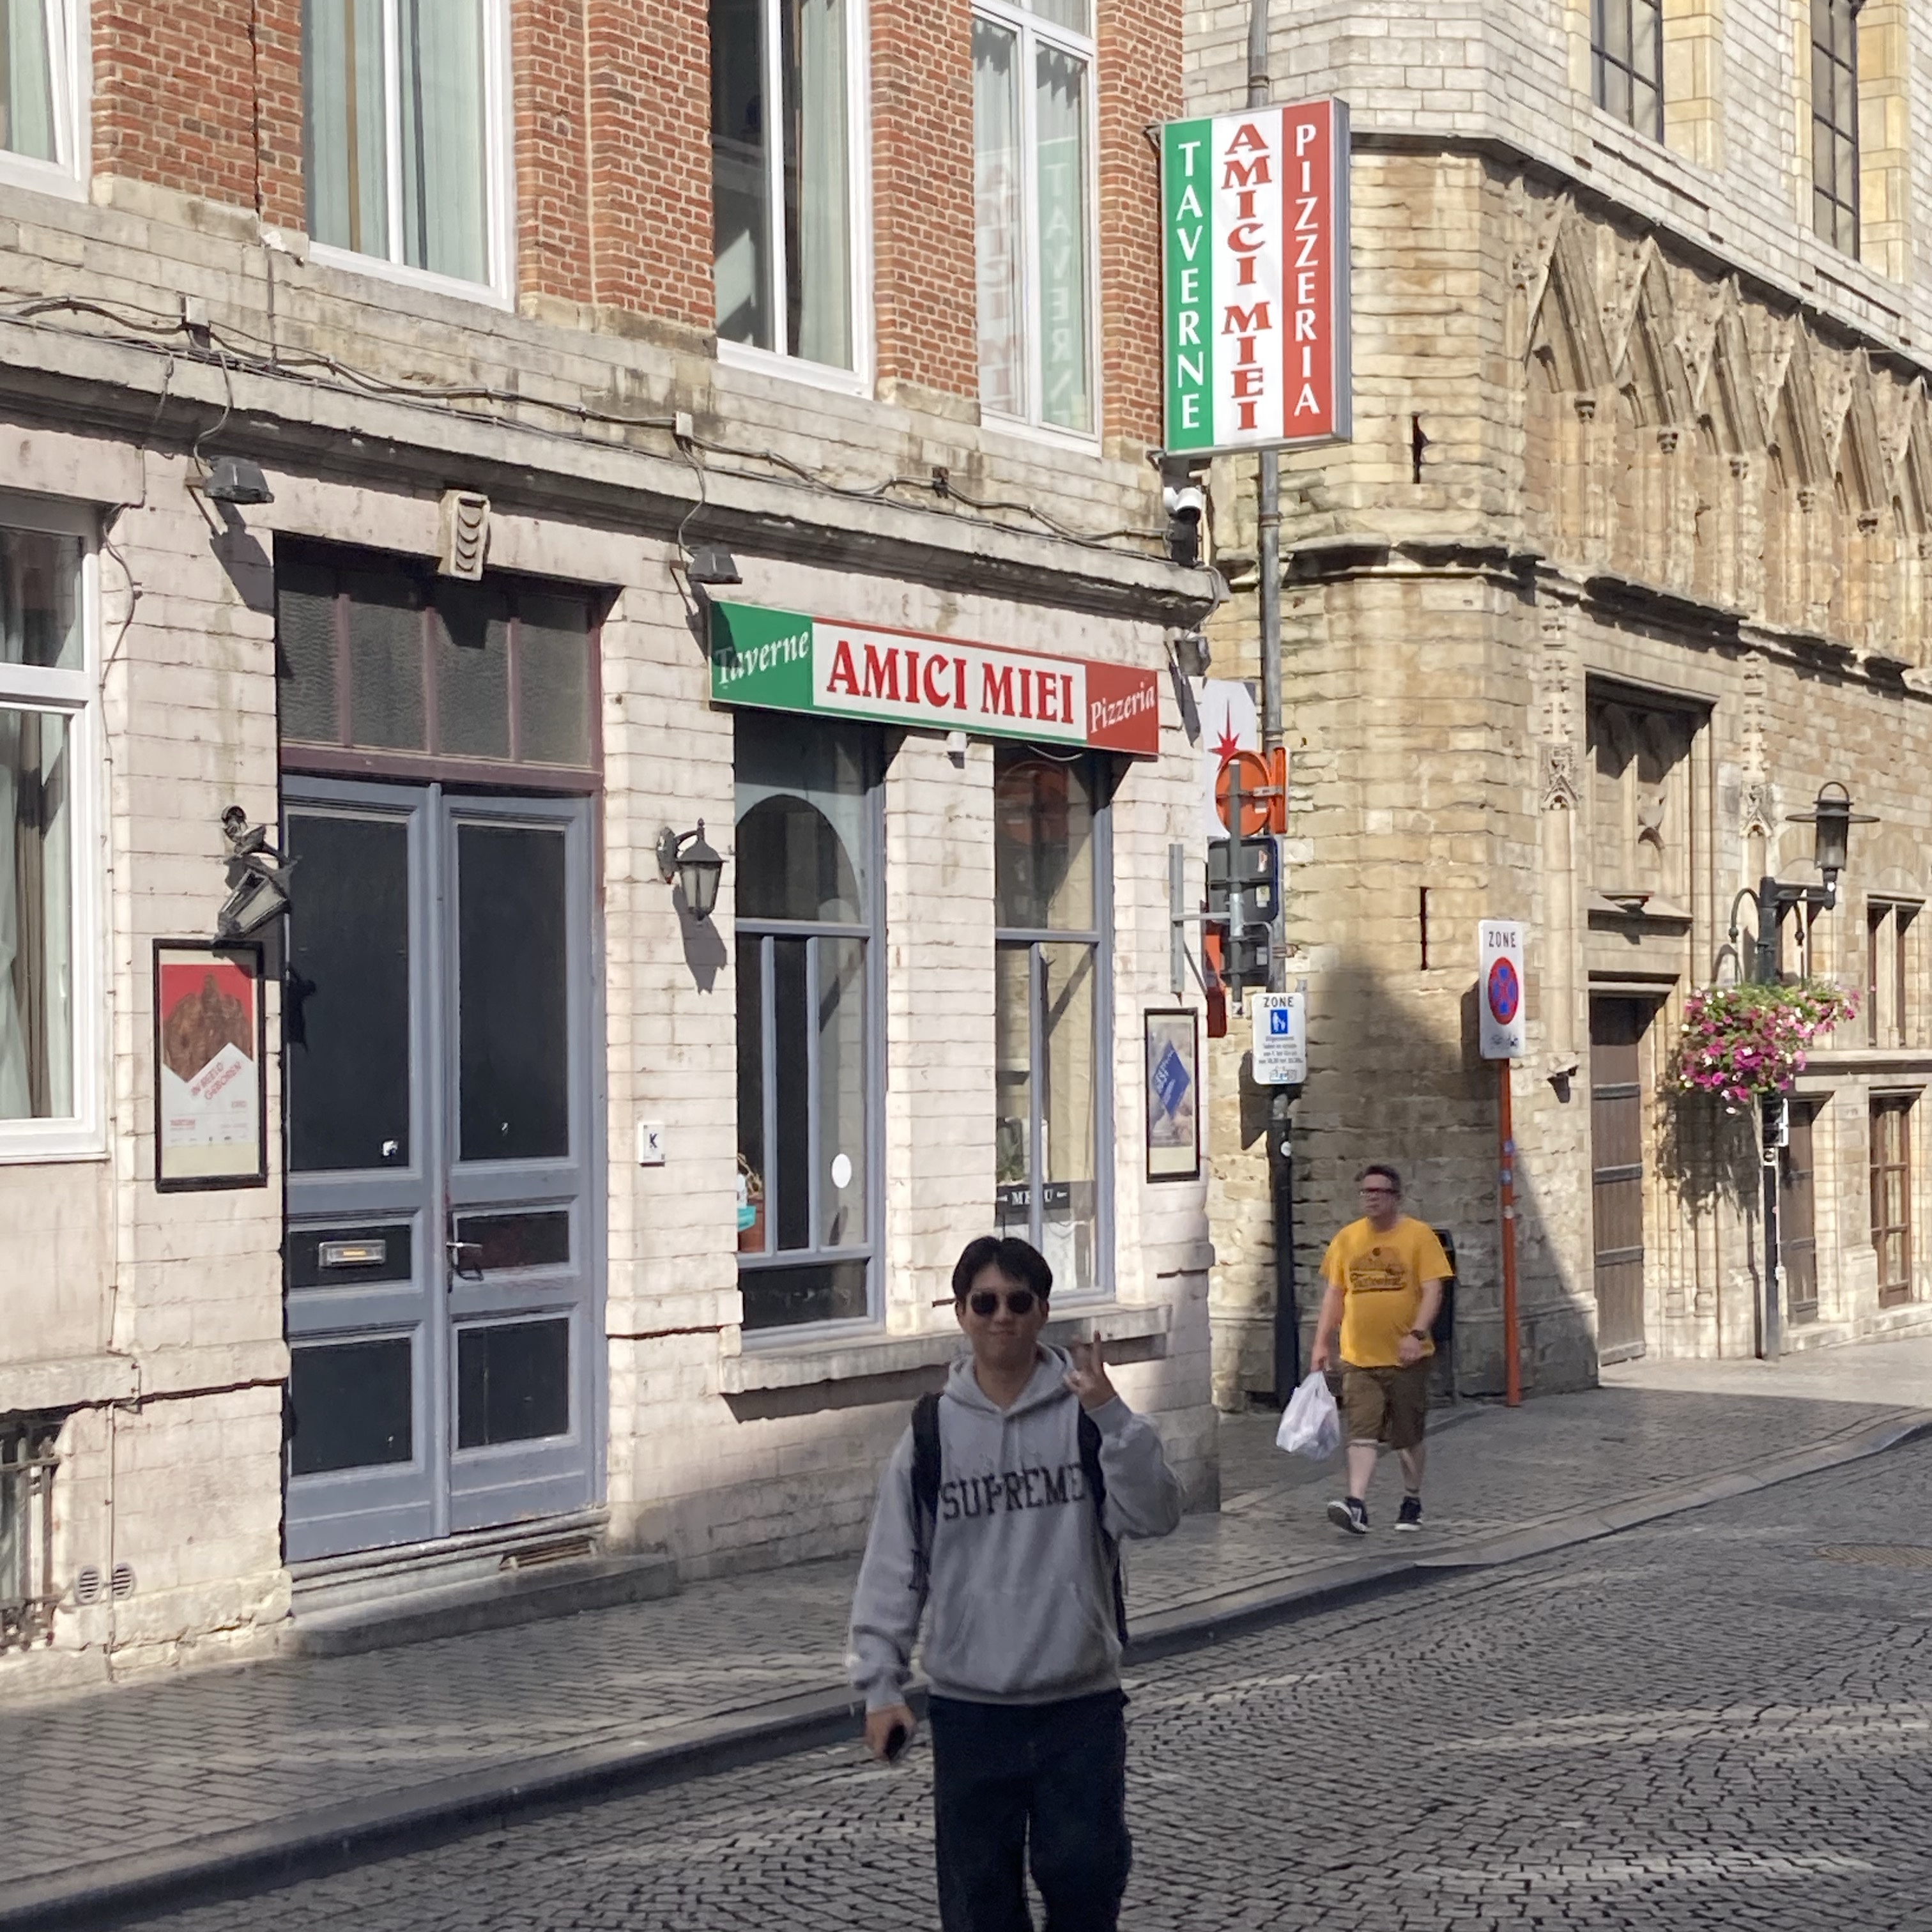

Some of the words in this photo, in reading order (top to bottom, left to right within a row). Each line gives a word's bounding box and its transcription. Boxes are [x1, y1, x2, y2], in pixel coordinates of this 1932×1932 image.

[1221, 123, 1272, 285] AMICI
[1176, 141, 1204, 429] TAVERNE
[1294, 124, 1320, 417] PIZZERIA
[1221, 302, 1273, 431] MIEI
[714, 631, 809, 685] Taverne
[827, 640, 968, 710] AMICI
[981, 663, 1074, 724] MIEI
[1090, 681, 1155, 734] Pizzeria
[1489, 931, 1517, 947] ZONE
[1263, 996, 1294, 1008] ZONE
[649, 1133, 658, 1148] K
